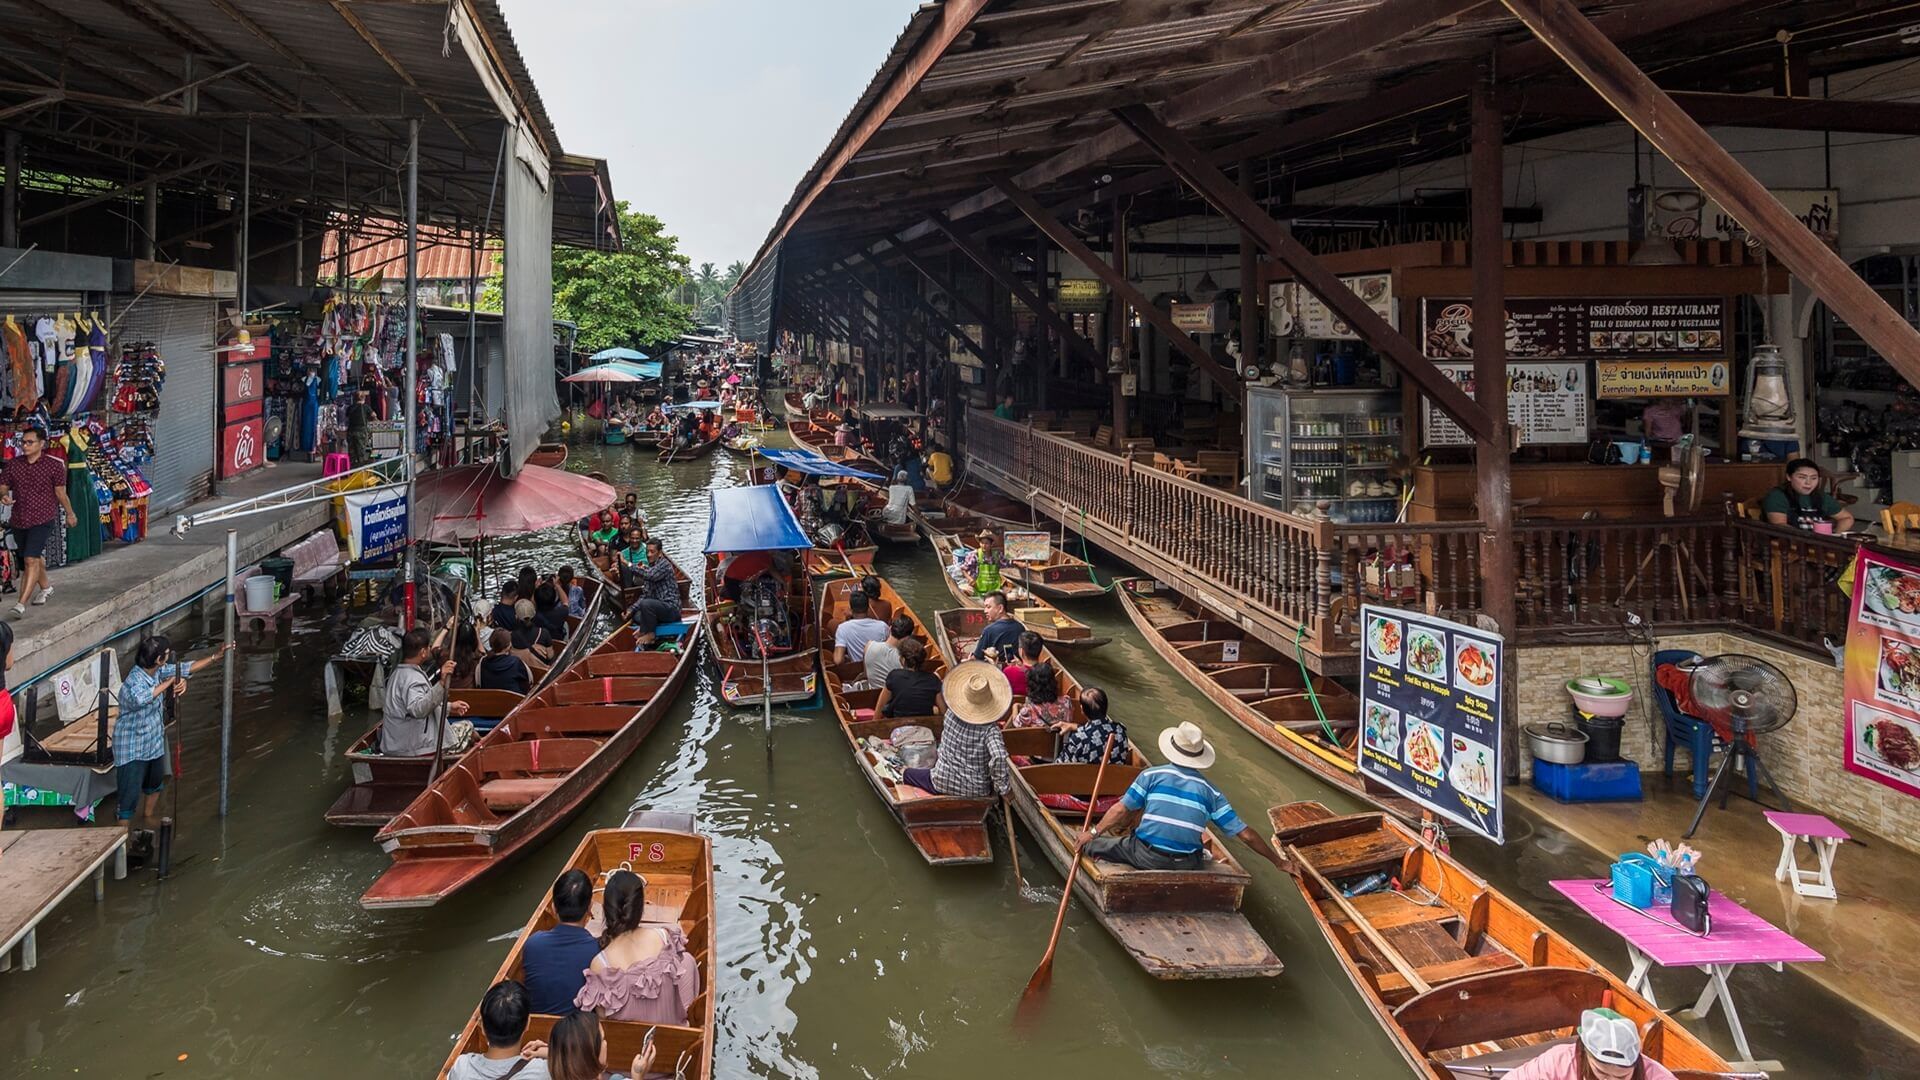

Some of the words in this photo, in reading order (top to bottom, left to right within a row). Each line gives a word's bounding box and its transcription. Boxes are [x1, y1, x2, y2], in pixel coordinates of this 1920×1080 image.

[1652, 304, 1720, 315] RESTAURANT
[1590, 320, 1606, 328] THAI
[1615, 320, 1651, 328] EUROPEAN
[1678, 319, 1720, 327] VEGETARIAN
[1602, 385, 1637, 395] Everything
[1640, 385, 1652, 395] Pay
[1664, 384, 1689, 392] Madam
[628, 843, 642, 862] F
[647, 842, 665, 862] 8
